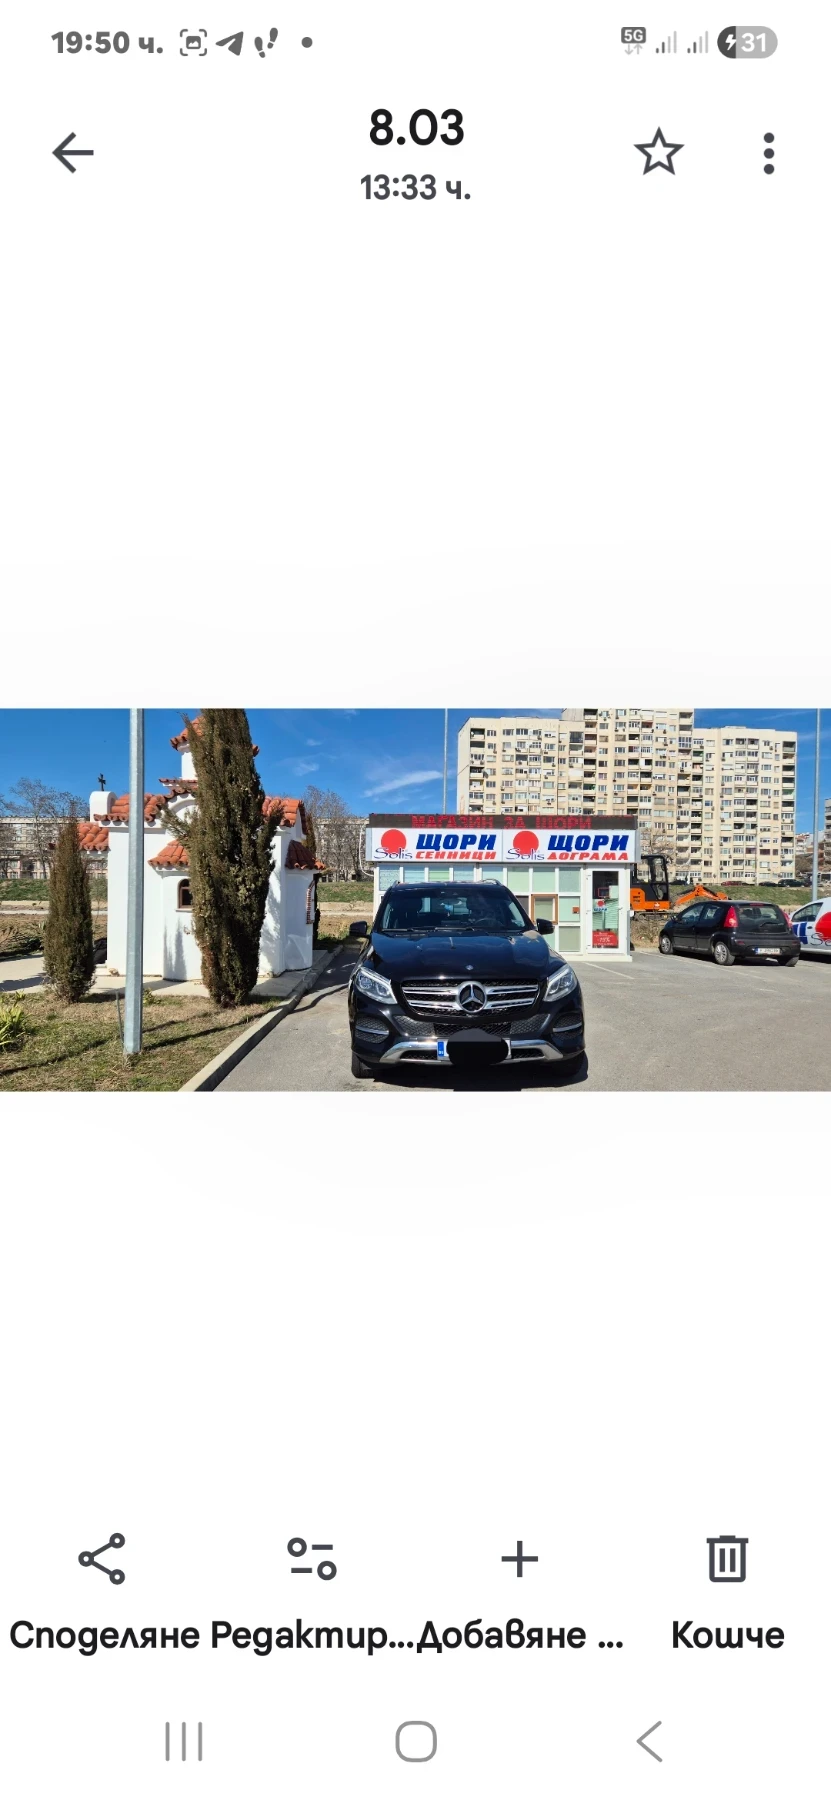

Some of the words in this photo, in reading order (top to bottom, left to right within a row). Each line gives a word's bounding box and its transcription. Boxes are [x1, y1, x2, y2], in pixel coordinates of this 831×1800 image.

[51, 31, 129, 54] 19:50
[139, 35, 163, 54] ч.
[624, 29, 644, 42] 5G
[741, 33, 766, 53] 31
[370, 109, 464, 146] 8.03
[361, 174, 436, 200] 13:33
[446, 179, 470, 200] ч.
[411, 816, 493, 829] МАГАЗИН
[503, 816, 526, 829] ЗА
[415, 833, 497, 851] ЩОРИ
[547, 834, 629, 852] ЩОРИ
[374, 847, 413, 860] Solis
[415, 851, 497, 860] СЕННИЦИ
[506, 847, 545, 860] Solis
[547, 852, 629, 861] ДОГРАМА
[10, 1620, 200, 1656] Споделяне
[417, 1618, 586, 1653] Добавяне
[673, 1621, 784, 1649] Кошче
